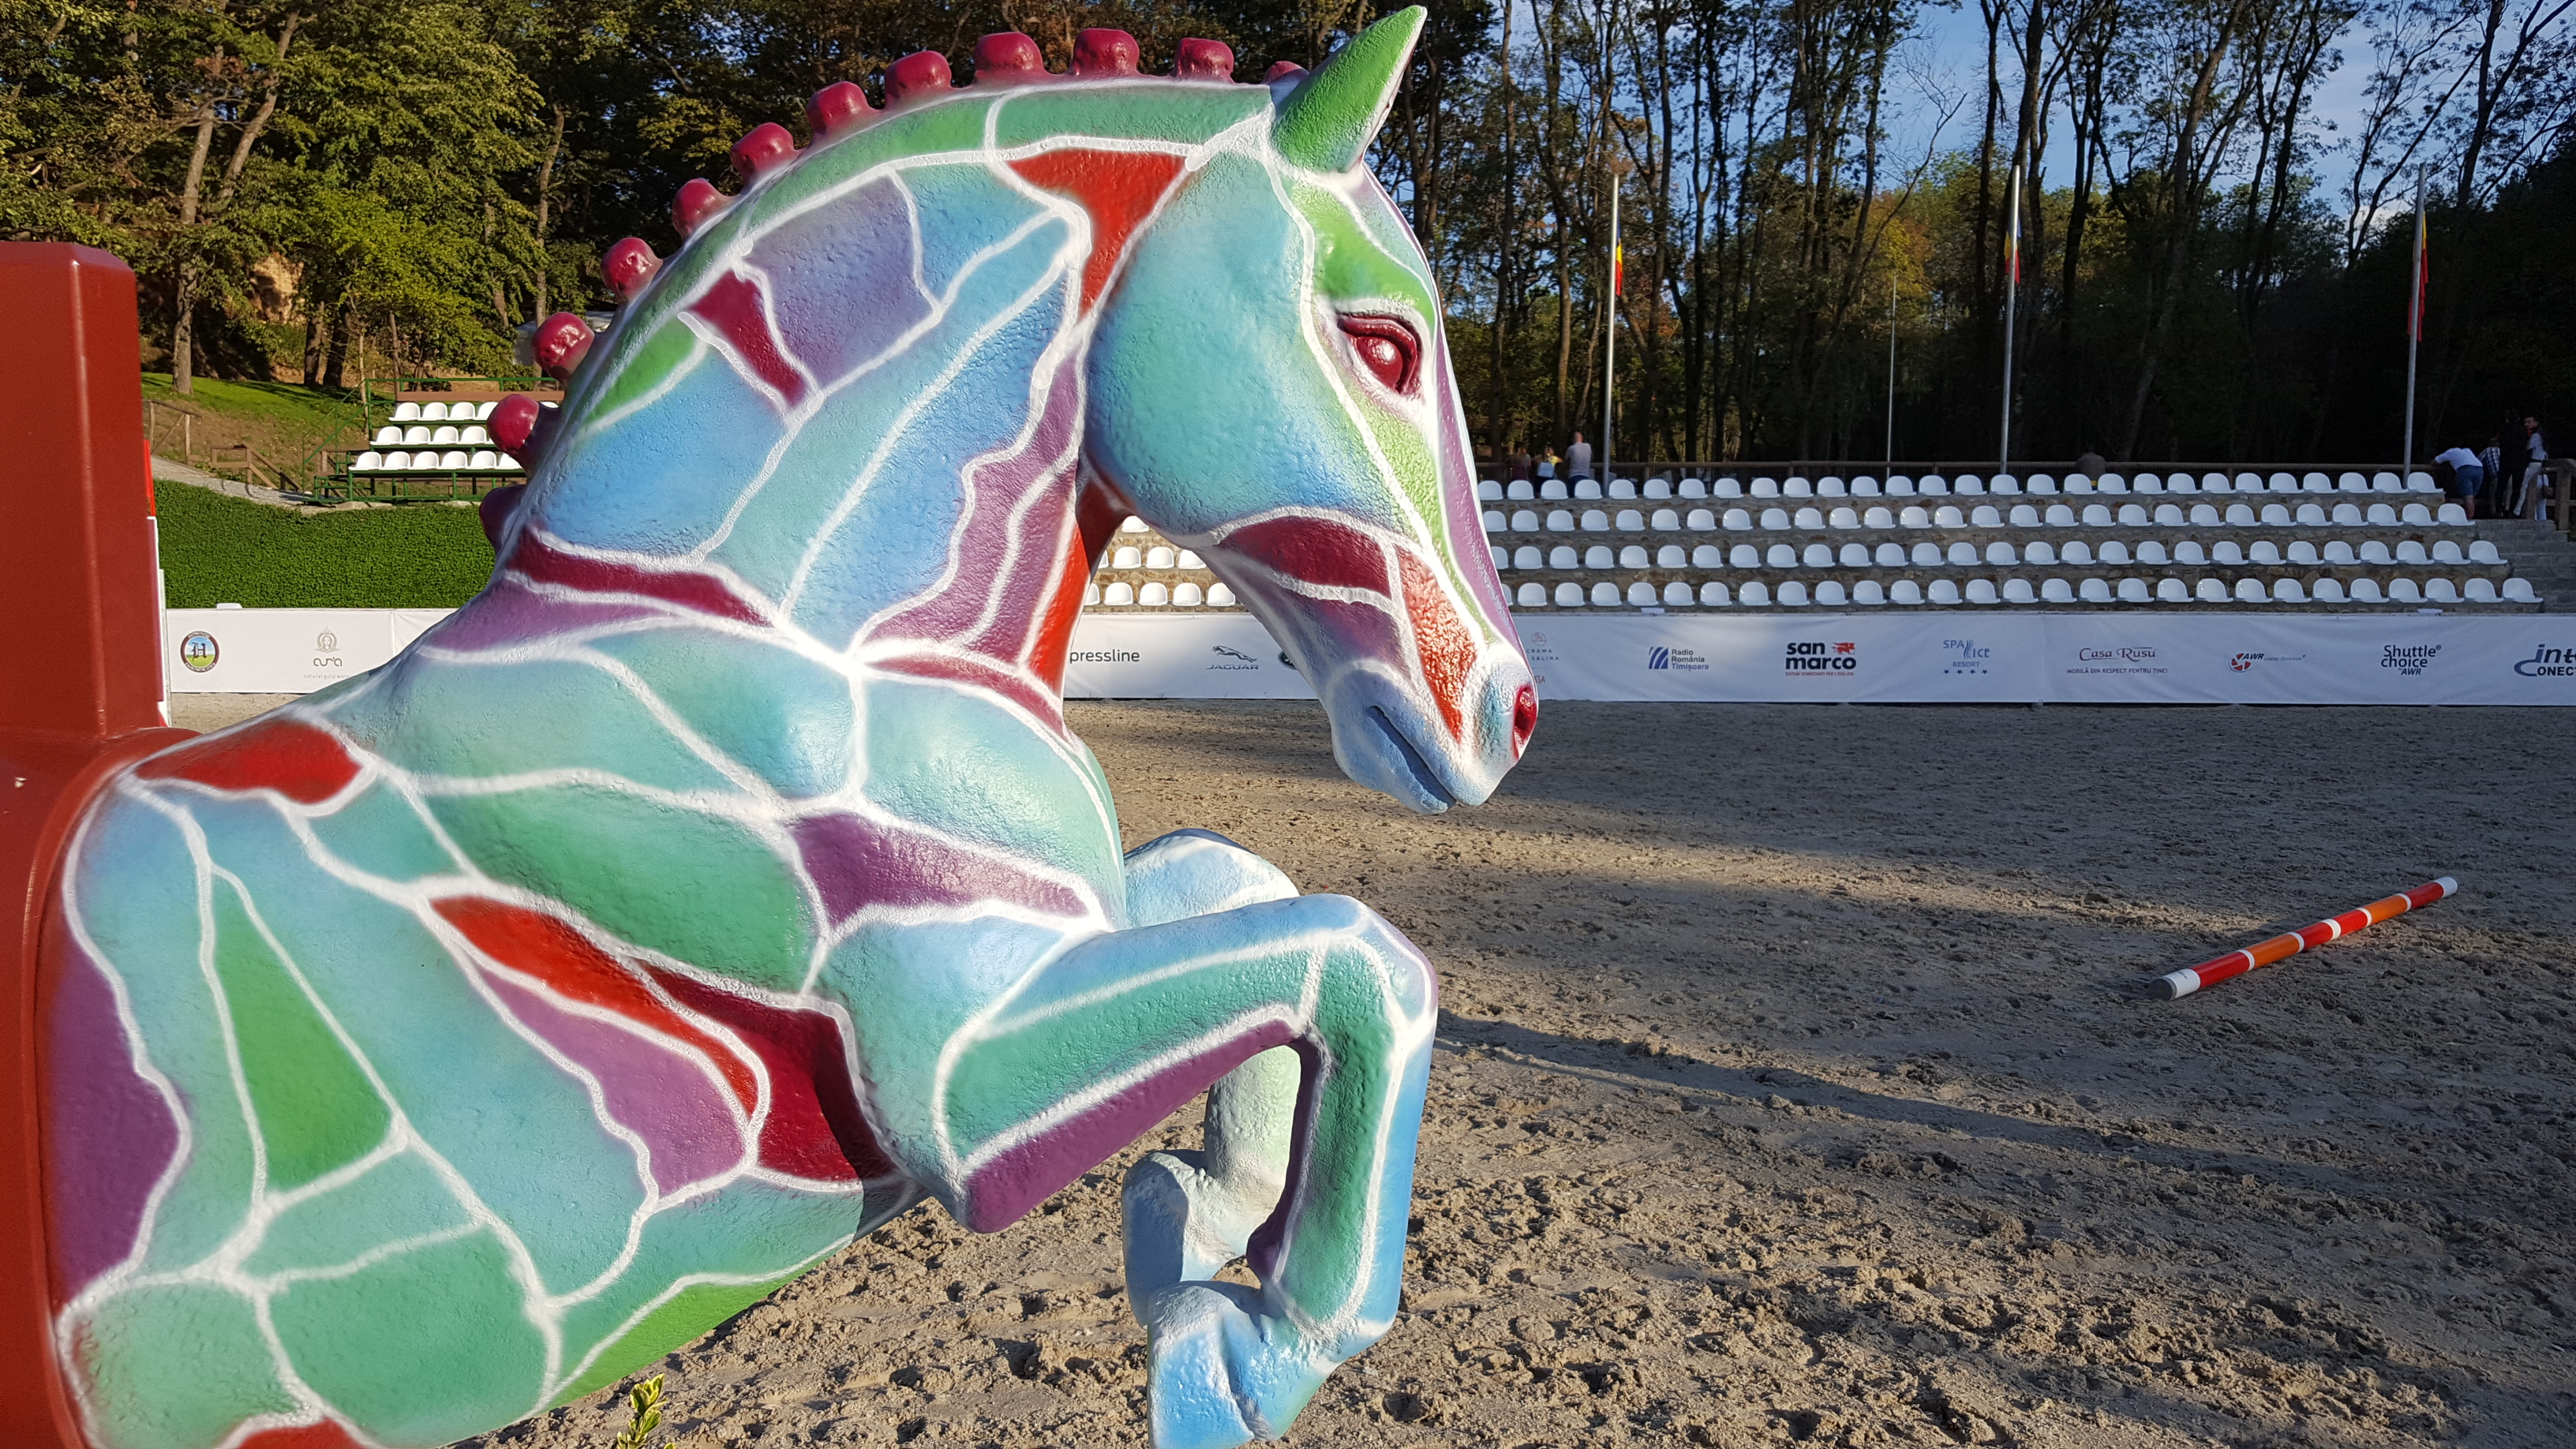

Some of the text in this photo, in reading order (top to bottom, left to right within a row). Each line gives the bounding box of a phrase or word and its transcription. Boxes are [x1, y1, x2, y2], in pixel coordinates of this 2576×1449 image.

[191, 642, 208, 661] H
[1786, 642, 1825, 655] san
[1943, 639, 1990, 658] SPA ICE
[2079, 647, 2155, 662] Casa Rusu
[2536, 644, 2576, 663] int
[1672, 663, 1709, 672] Timișoara
[1785, 657, 1856, 670] marco
[2380, 655, 2428, 668] choice
